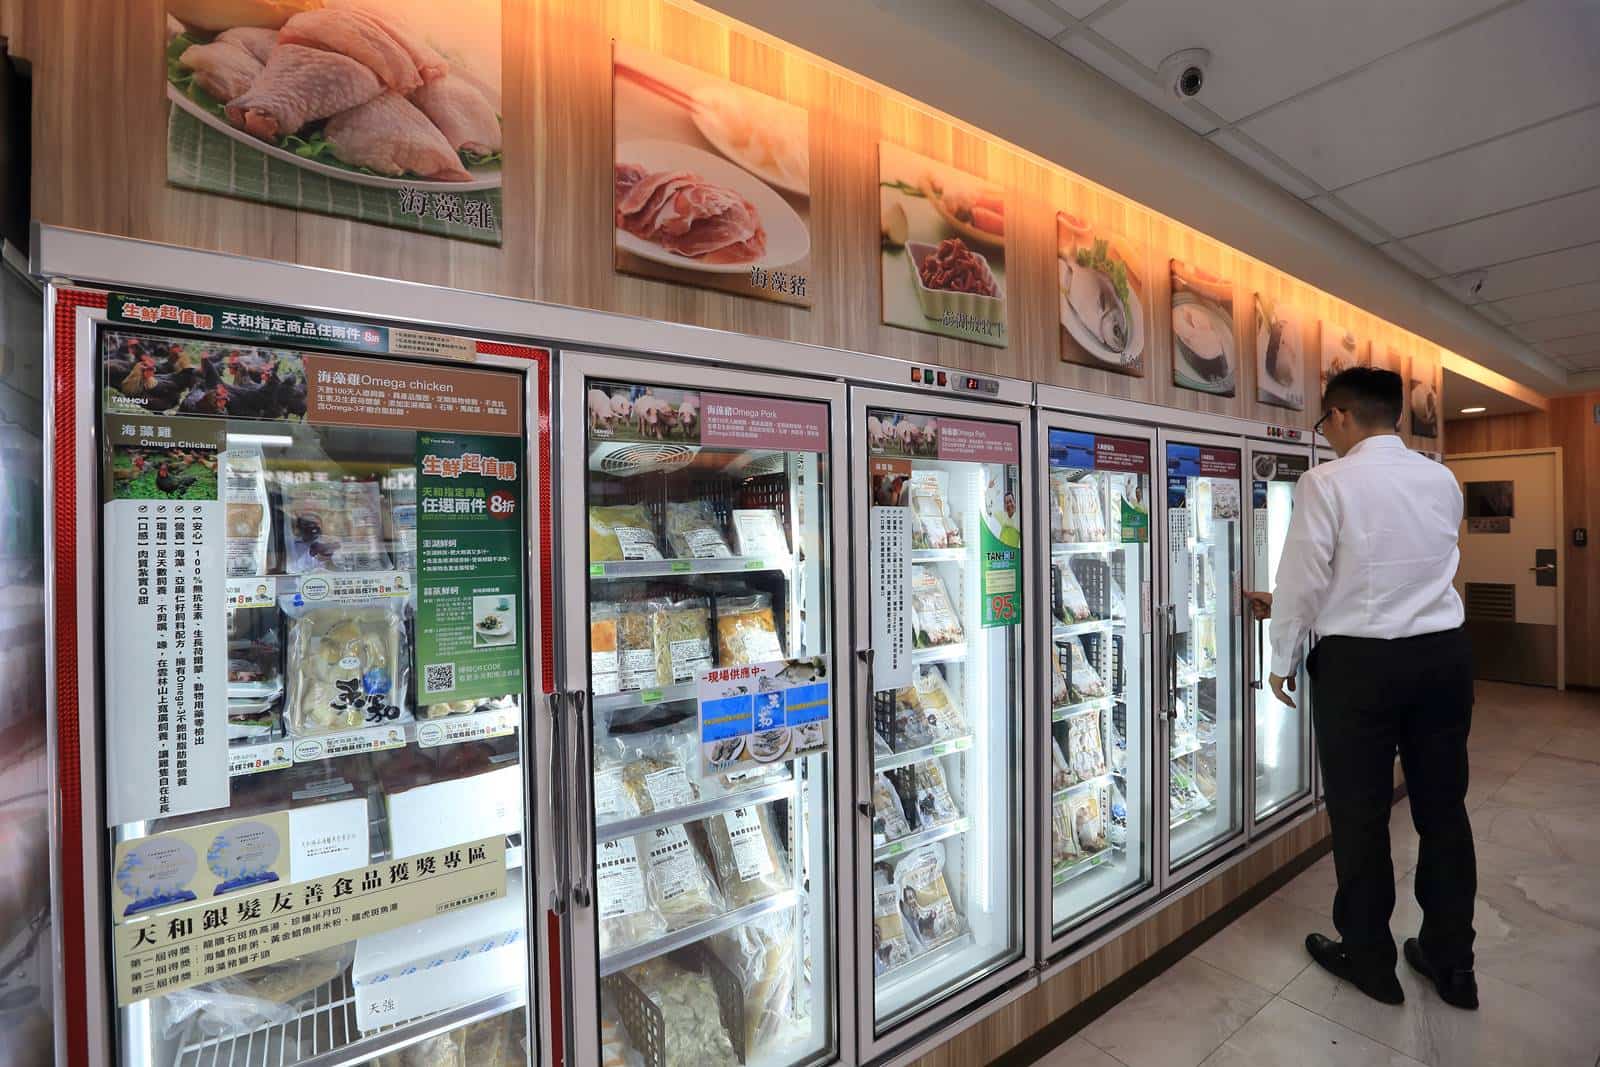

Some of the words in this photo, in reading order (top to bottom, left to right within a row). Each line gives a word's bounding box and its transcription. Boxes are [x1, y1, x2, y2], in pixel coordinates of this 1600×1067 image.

[398, 184, 494, 231] 海藻雞
[751, 264, 807, 297] 海藻豬
[122, 303, 213, 330] 生鮮超值購
[409, 378, 454, 392] chicken
[111, 396, 148, 405] TANHOU
[120, 424, 173, 438] 海藻雞
[140, 439, 176, 450] Omega
[178, 440, 217, 450] Chicken
[422, 452, 516, 480] 生鮮超值購
[422, 487, 486, 497] 天和指定商品
[422, 498, 486, 513] 任選兩件
[490, 495, 516, 513] 8折
[992, 594, 1013, 619] 95
[134, 844, 487, 947] 天和銀髮友善食品獲獎專區
